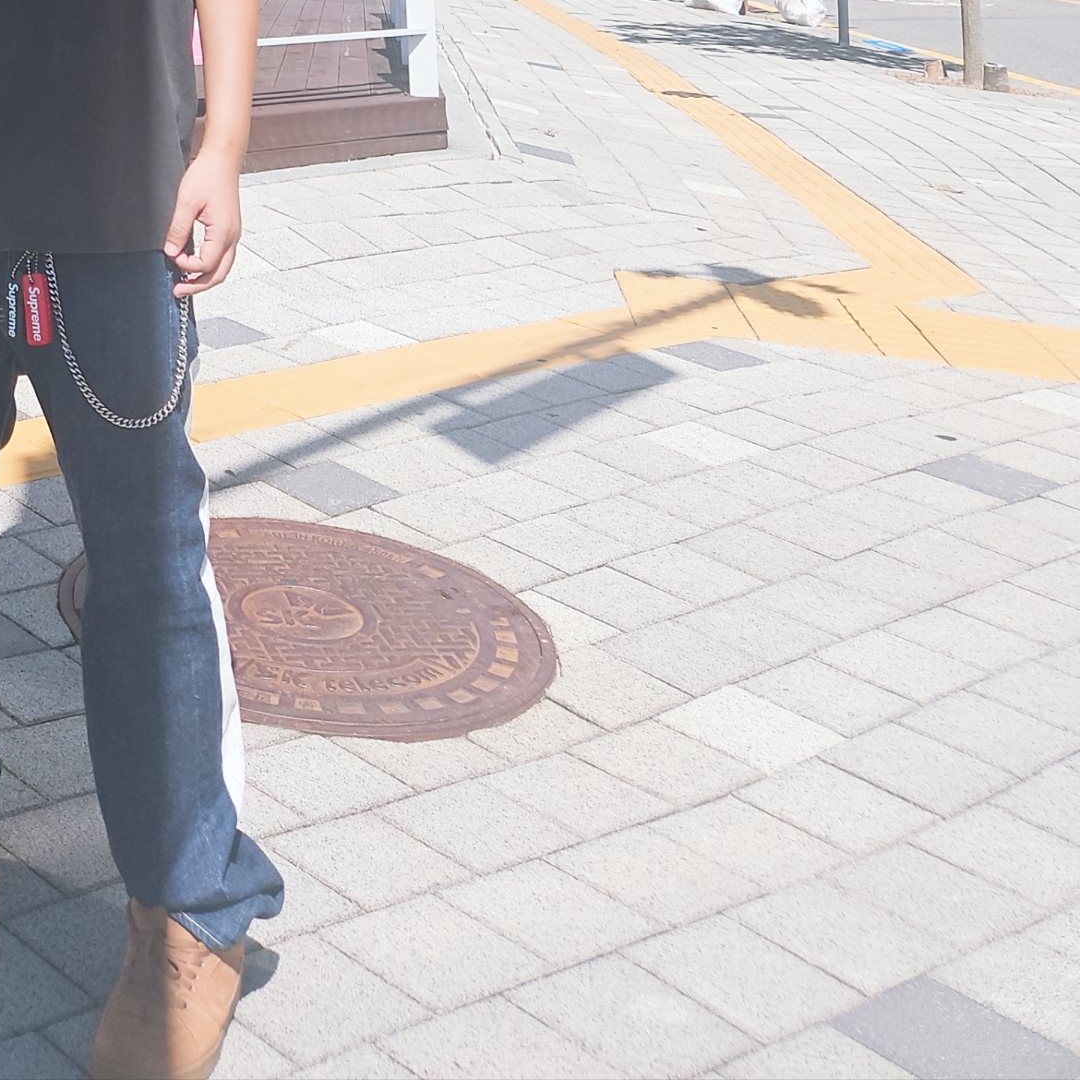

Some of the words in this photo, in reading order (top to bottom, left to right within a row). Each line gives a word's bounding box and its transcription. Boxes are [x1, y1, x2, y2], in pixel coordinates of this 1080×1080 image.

[5, 282, 19, 339] Supreme
[27, 286, 42, 342] Supreme
[322, 666, 445, 693] telecom
